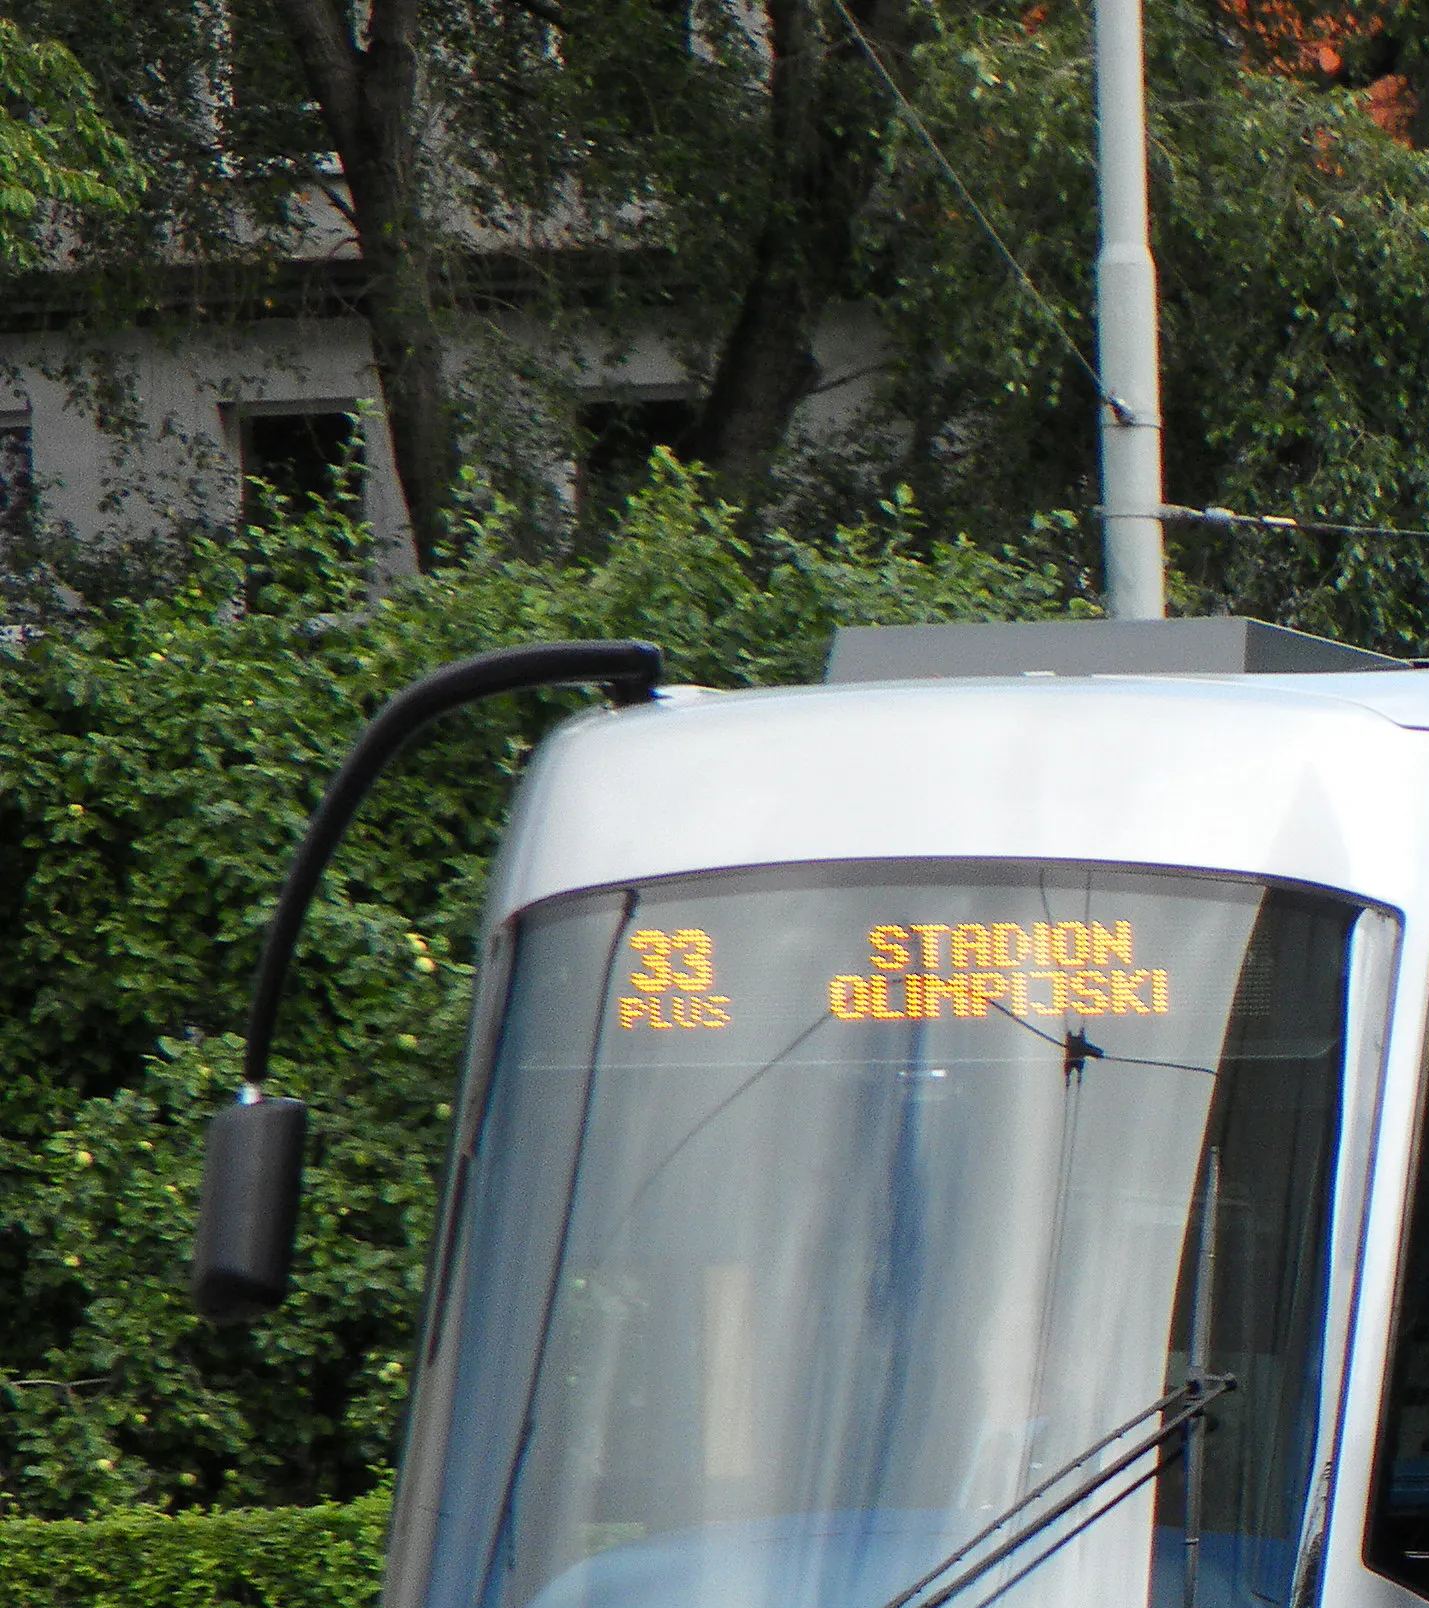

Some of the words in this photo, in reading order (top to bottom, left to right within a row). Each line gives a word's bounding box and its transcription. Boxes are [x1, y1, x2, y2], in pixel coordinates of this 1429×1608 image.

[629, 928, 713, 993] 33
[868, 919, 1133, 970] STADION
[618, 995, 732, 1030] PLUS
[828, 967, 1168, 1020] OLIMPIJSKI
